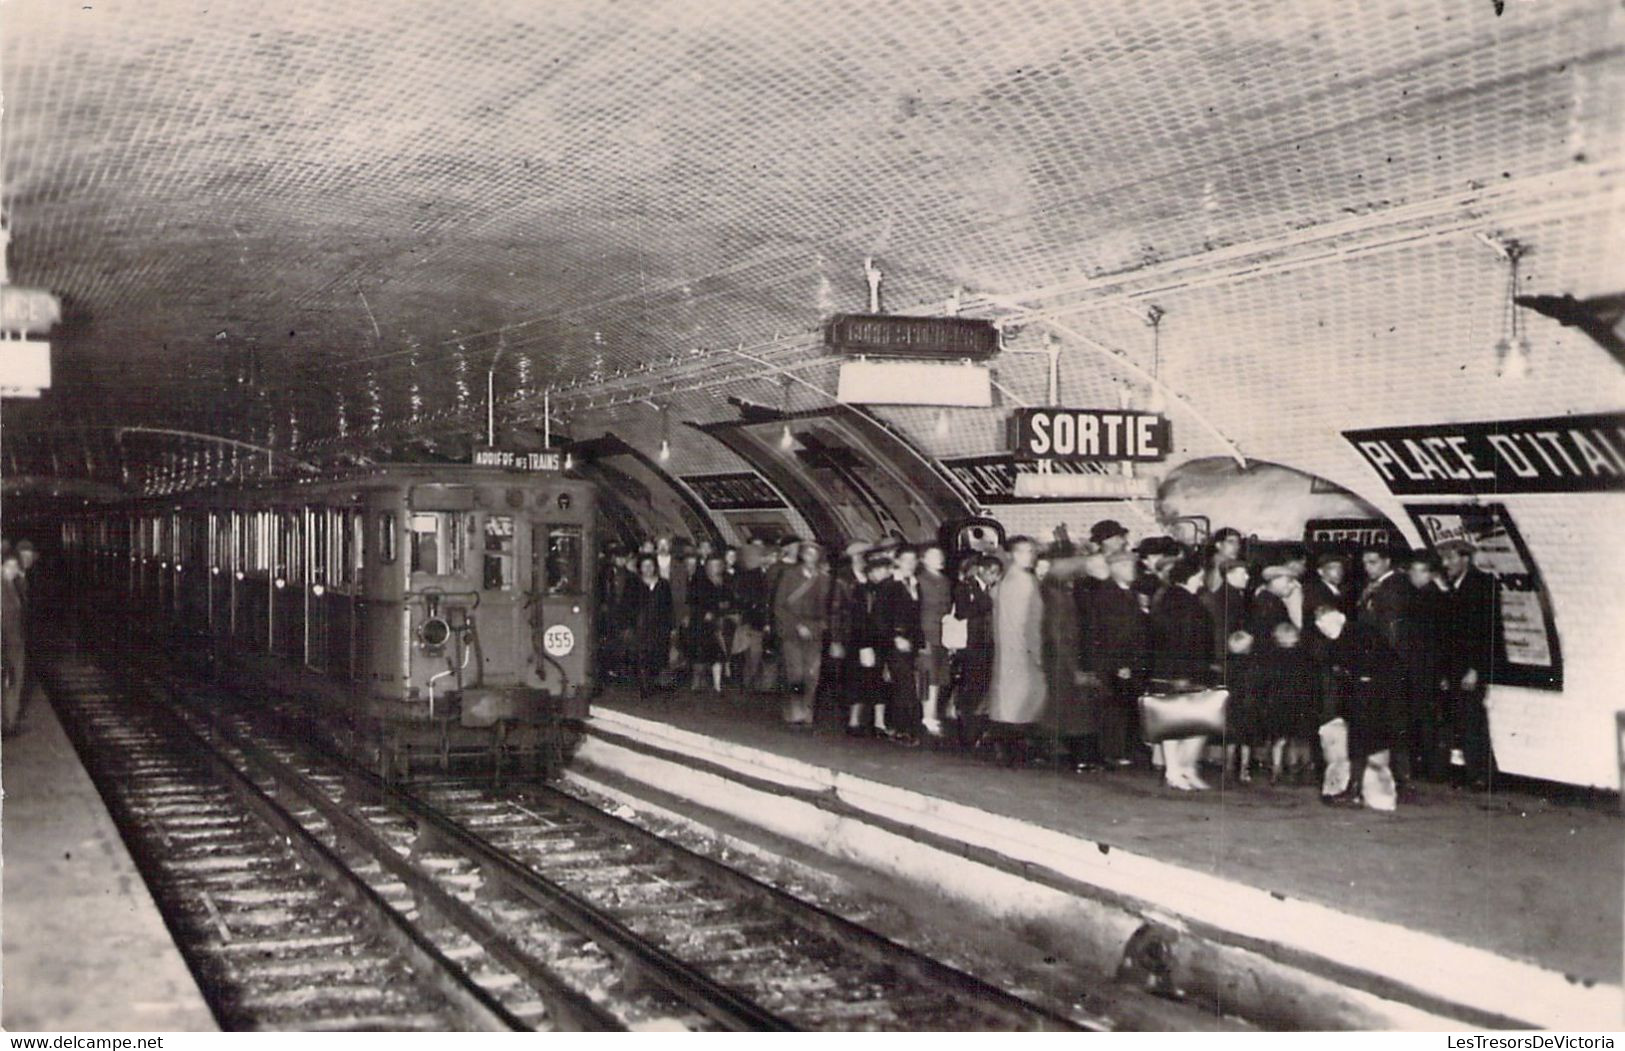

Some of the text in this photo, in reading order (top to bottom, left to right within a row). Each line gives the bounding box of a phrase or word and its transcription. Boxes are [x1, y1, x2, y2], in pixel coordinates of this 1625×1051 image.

[1030, 413, 1159, 456] SORTIE
[528, 452, 560, 471] TRAINS
[1358, 427, 1624, 481] PLACE D'ITAL
[546, 632, 573, 649] 355
